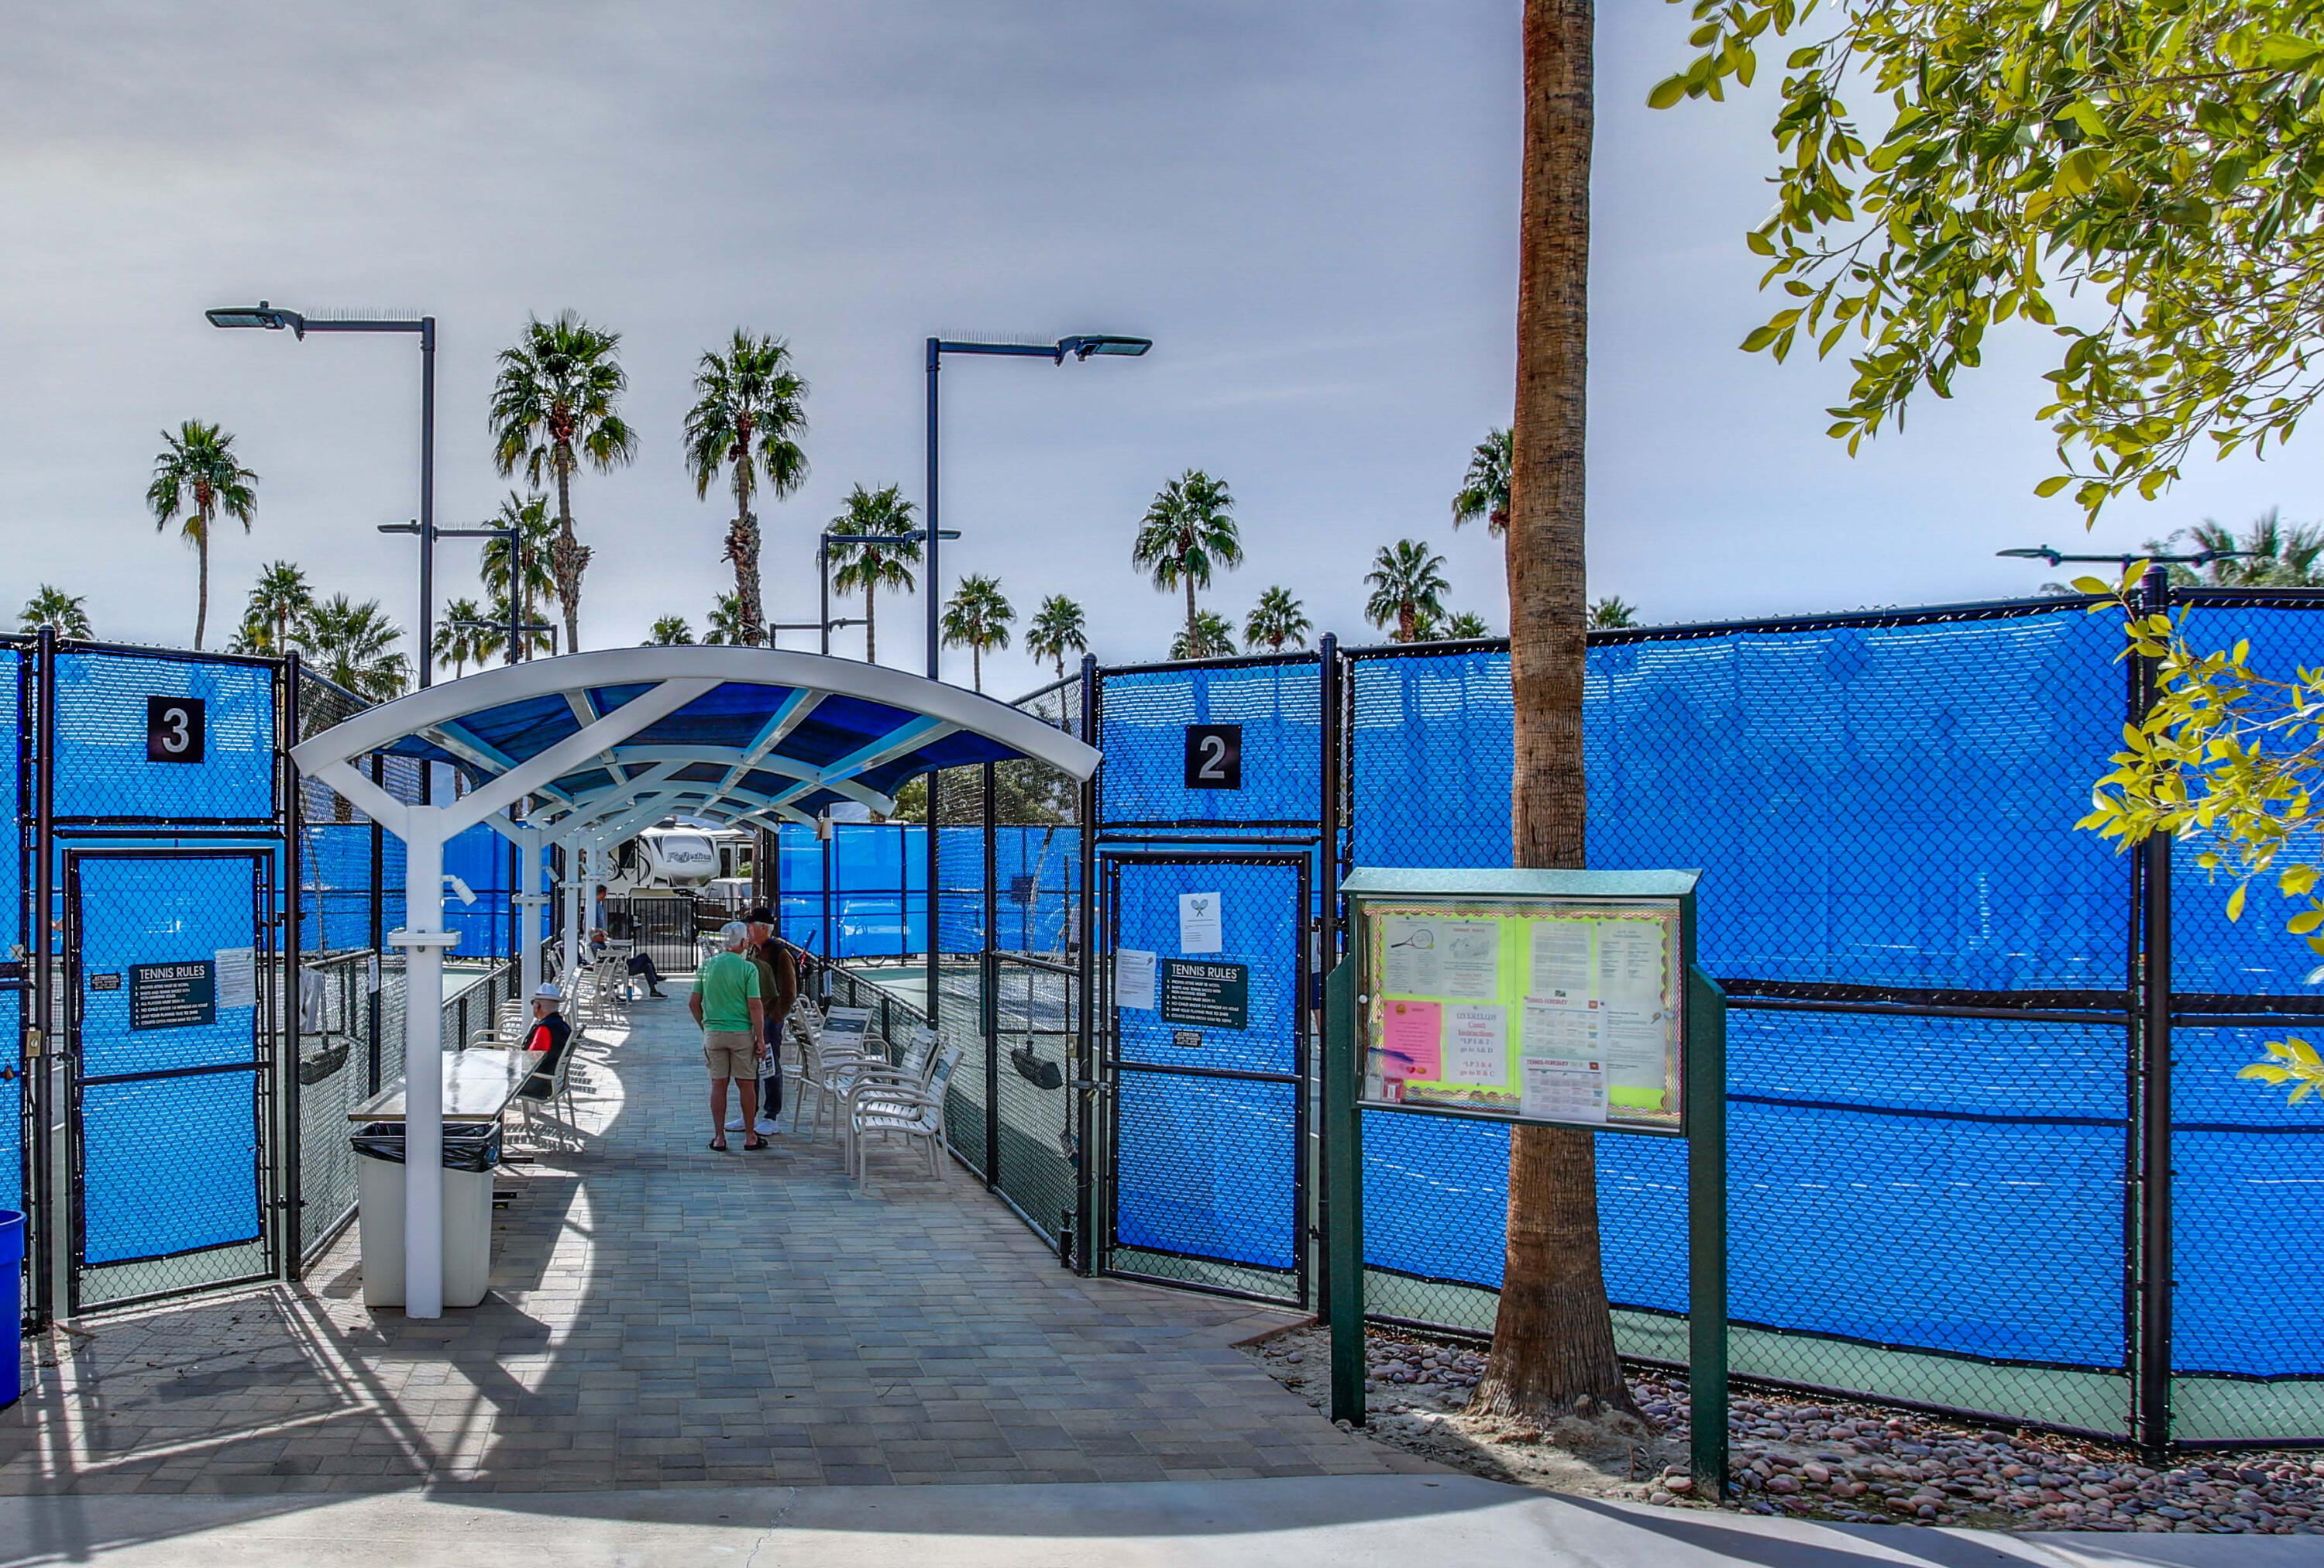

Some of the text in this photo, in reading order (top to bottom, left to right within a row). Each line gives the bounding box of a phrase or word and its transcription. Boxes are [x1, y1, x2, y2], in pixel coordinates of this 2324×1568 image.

[163, 707, 189, 753] 3
[1198, 734, 1226, 779] 2
[139, 965, 204, 979] TENNIS RULES
[1171, 964, 1236, 978] TENNIS RULES
